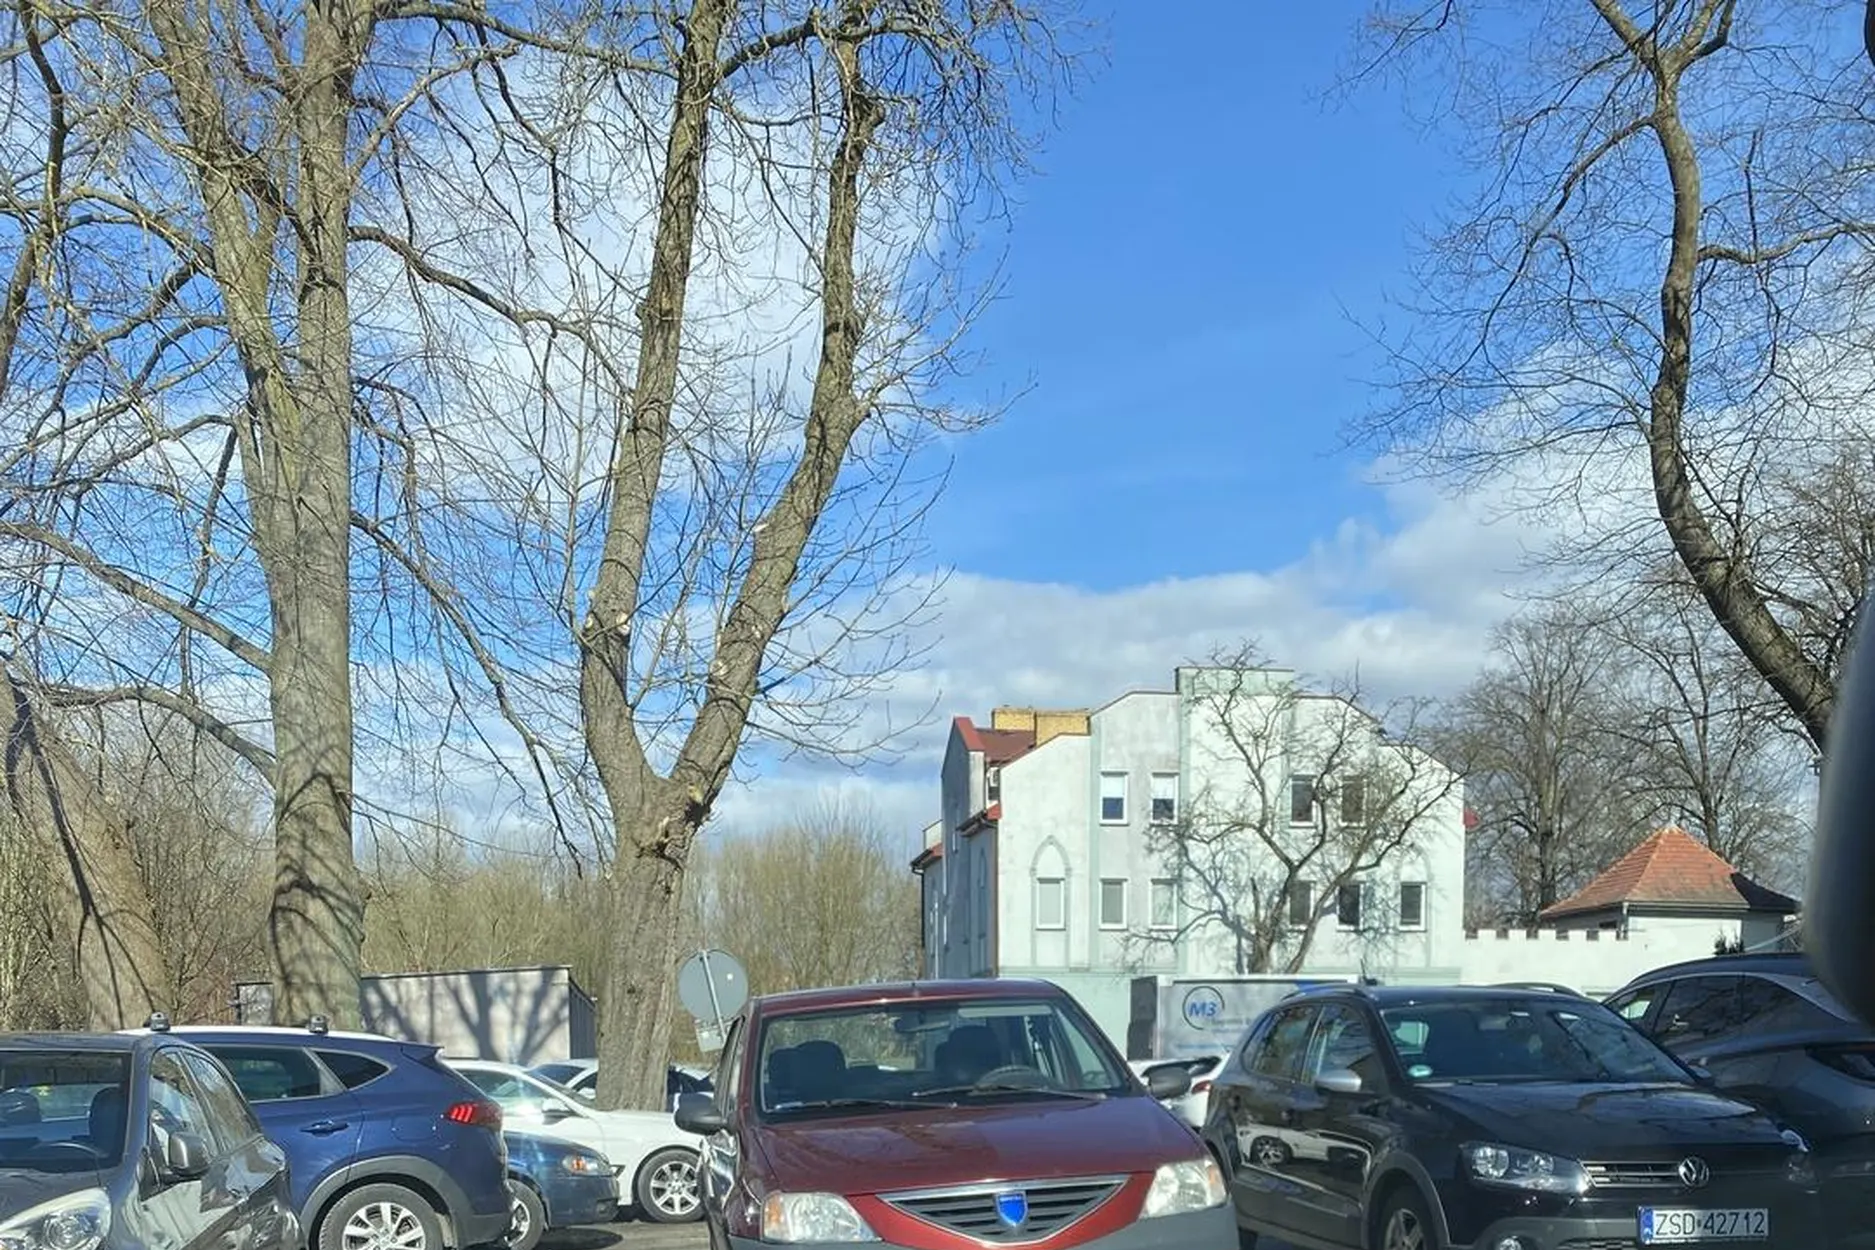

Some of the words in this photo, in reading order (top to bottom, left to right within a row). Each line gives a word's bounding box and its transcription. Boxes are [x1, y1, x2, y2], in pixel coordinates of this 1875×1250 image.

[1188, 1002, 1217, 1017] M3
[1655, 1213, 1695, 1236] ZSD
[1703, 1211, 1765, 1235] 42712
